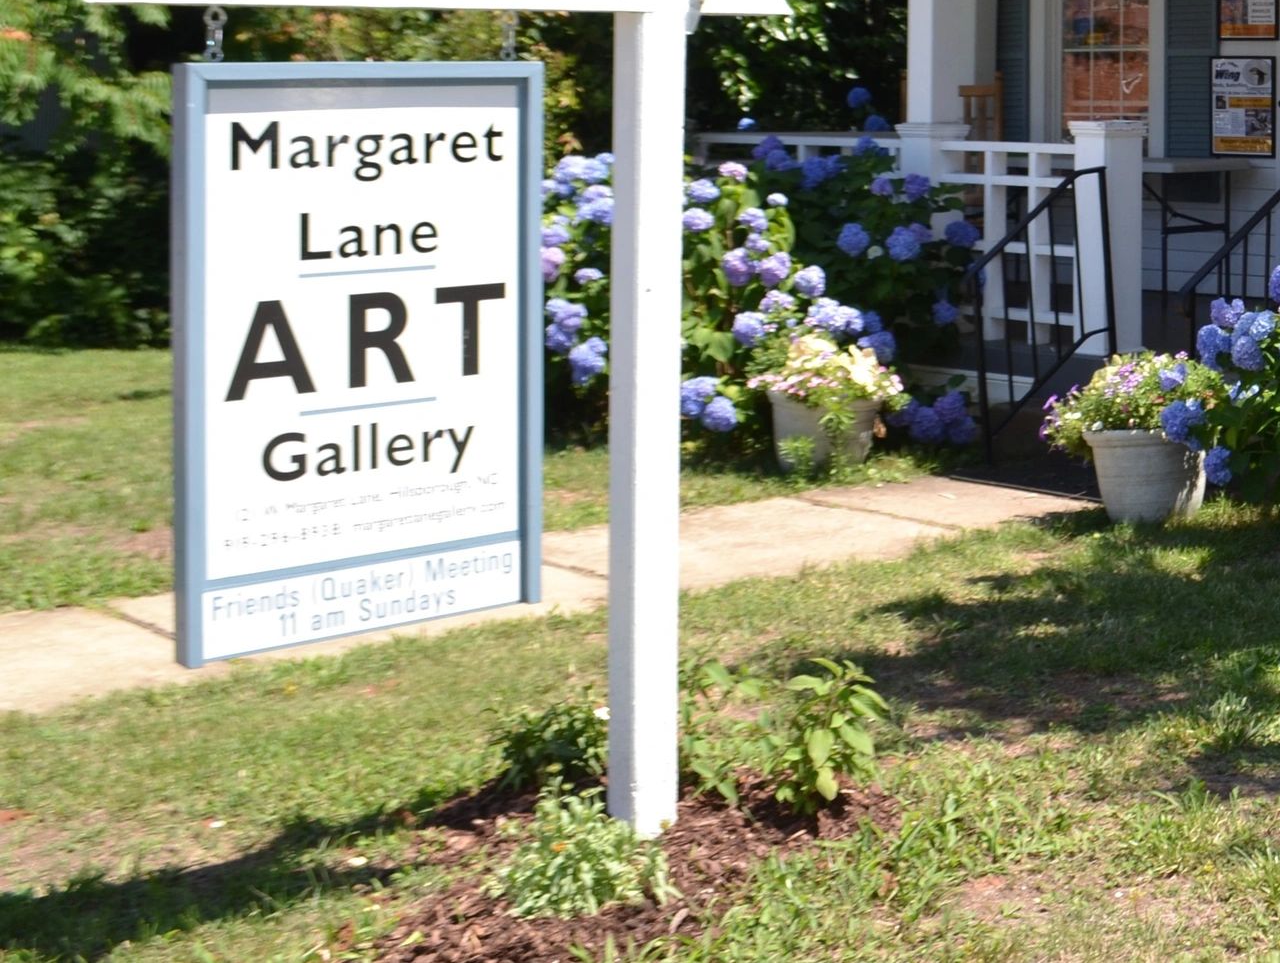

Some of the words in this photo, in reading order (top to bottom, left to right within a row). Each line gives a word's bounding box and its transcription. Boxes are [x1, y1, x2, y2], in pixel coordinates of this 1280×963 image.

[232, 120, 503, 182] Margaret
[300, 212, 438, 261] Lane
[225, 282, 506, 402] ART
[262, 422, 474, 482] Gallery
[211, 585, 300, 622] Friends
[312, 569, 414, 605] (Quaker)
[424, 552, 512, 582] Meeting
[279, 611, 297, 637] 11
[311, 609, 345, 631] am
[358, 588, 457, 622] Sundays
